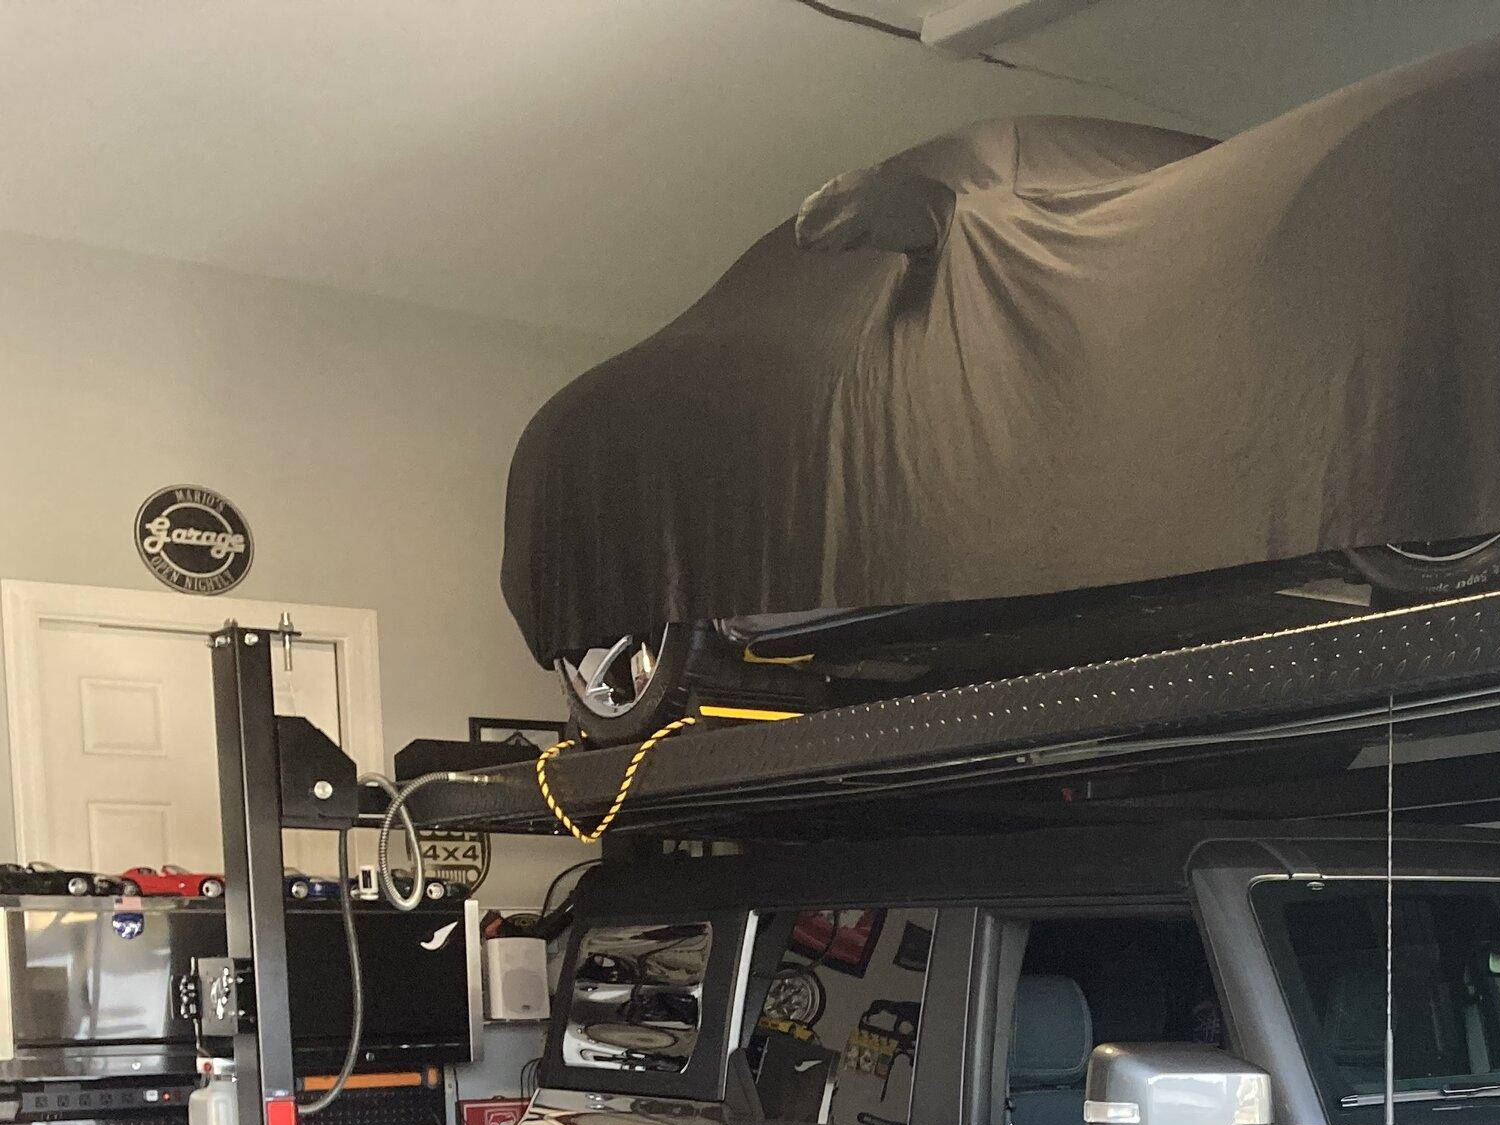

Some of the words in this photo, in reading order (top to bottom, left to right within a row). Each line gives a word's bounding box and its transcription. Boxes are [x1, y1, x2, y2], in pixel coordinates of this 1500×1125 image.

[176, 489, 225, 512] MARIO'S
[144, 516, 245, 559] Garage
[151, 556, 181, 583] OPEN
[185, 568, 235, 592] NIGHTLY
